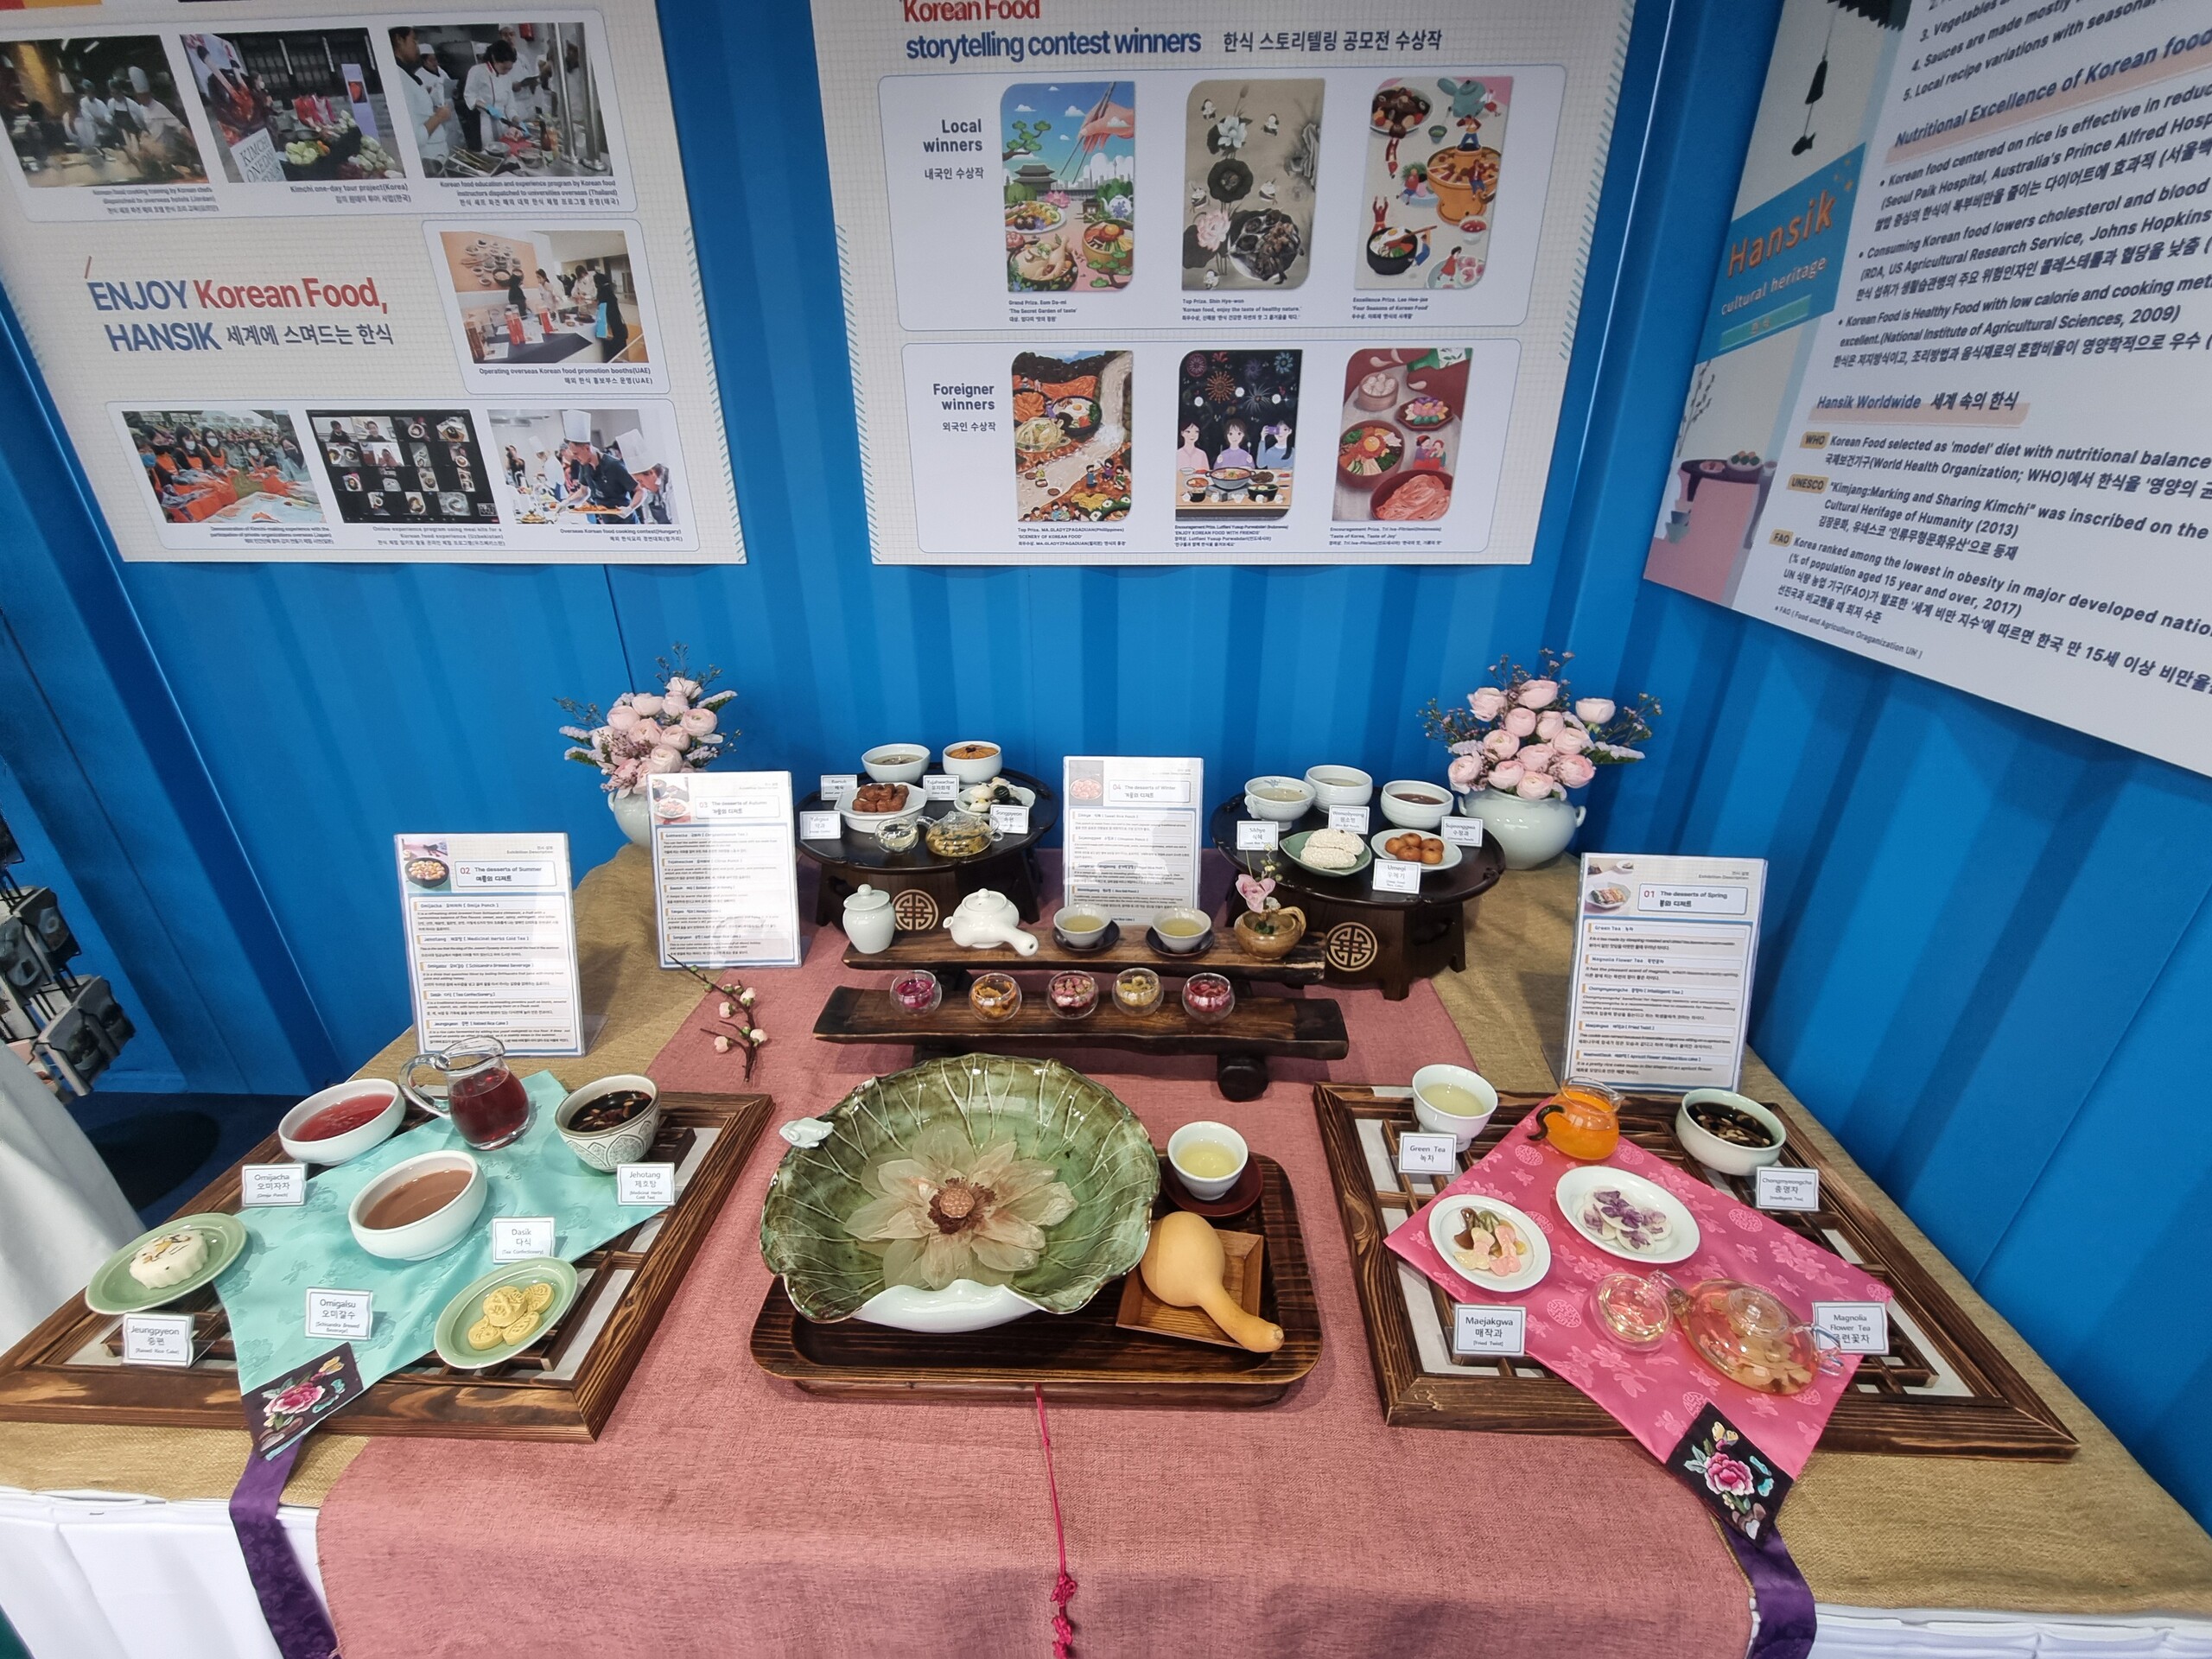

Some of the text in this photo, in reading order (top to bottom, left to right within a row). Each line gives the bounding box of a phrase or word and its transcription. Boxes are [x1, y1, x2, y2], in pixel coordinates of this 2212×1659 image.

[904, 0, 1040, 22] Korean Food
[906, 27, 1441, 64] storytelling contest winners 한식 스토리텔링 공모전 수상작
[1911, 1, 2071, 72] 4. Sauces are made mostly
[1903, 22, 2083, 101] 5. Local recipe variations with
[1896, 47, 2157, 146] Nutritional Excellence of Korean
[942, 118, 982, 133] Local
[923, 137, 982, 152] winners
[1889, 98, 2158, 187] Korean food centered on rice is effective in
[925, 167, 983, 180] 내국인 수상작
[359, 183, 408, 192] project(Korea)
[1727, 189, 1836, 278] Hansik
[86, 277, 388, 315] ENJOY Korean Food,
[1721, 257, 1827, 315] cultural heritage
[105, 322, 394, 352] HANSIK 세계에 스며드는 한식
[933, 383, 995, 397] Foreigner
[1817, 392, 2018, 411] Hansik Worldwide 세계 속의 한식
[942, 398, 995, 410] winners
[943, 422, 995, 431] 외국인 수상작
[1805, 435, 1826, 445] WHO
[1830, 436, 1861, 448] Korean
[1863, 437, 1885, 448] Food
[1888, 439, 1930, 451] selected
[1935, 442, 1948, 452] as
[1995, 443, 2019, 457] diet
[2024, 445, 2053, 460] with
[2056, 448, 2138, 465] nutritional
[2140, 450, 2212, 470] balance
[1791, 477, 1825, 490] UNESCO
[1912, 491, 1932, 504] and
[1936, 493, 1982, 512] Sharing
[2038, 506, 2066, 520] was
[2070, 508, 2145, 532] inscribed
[2150, 519, 2171, 534] on
[2177, 521, 2209, 540] the
[1825, 499, 1862, 516] Cultural
[1905, 508, 1916, 522] of
[1919, 512, 1973, 533] Humanity
[1976, 519, 2019, 539] (2013)
[1774, 532, 2158, 623] FAO Korea ranked among the lowest in obesity in major developed
[1420, 1154, 1434, 1163] 녹차
[131, 1325, 180, 1336] Jeungpyeon
[1465, 1317, 1513, 1327] Maejakgwa
[1475, 1329, 1503, 1338] 매작과
